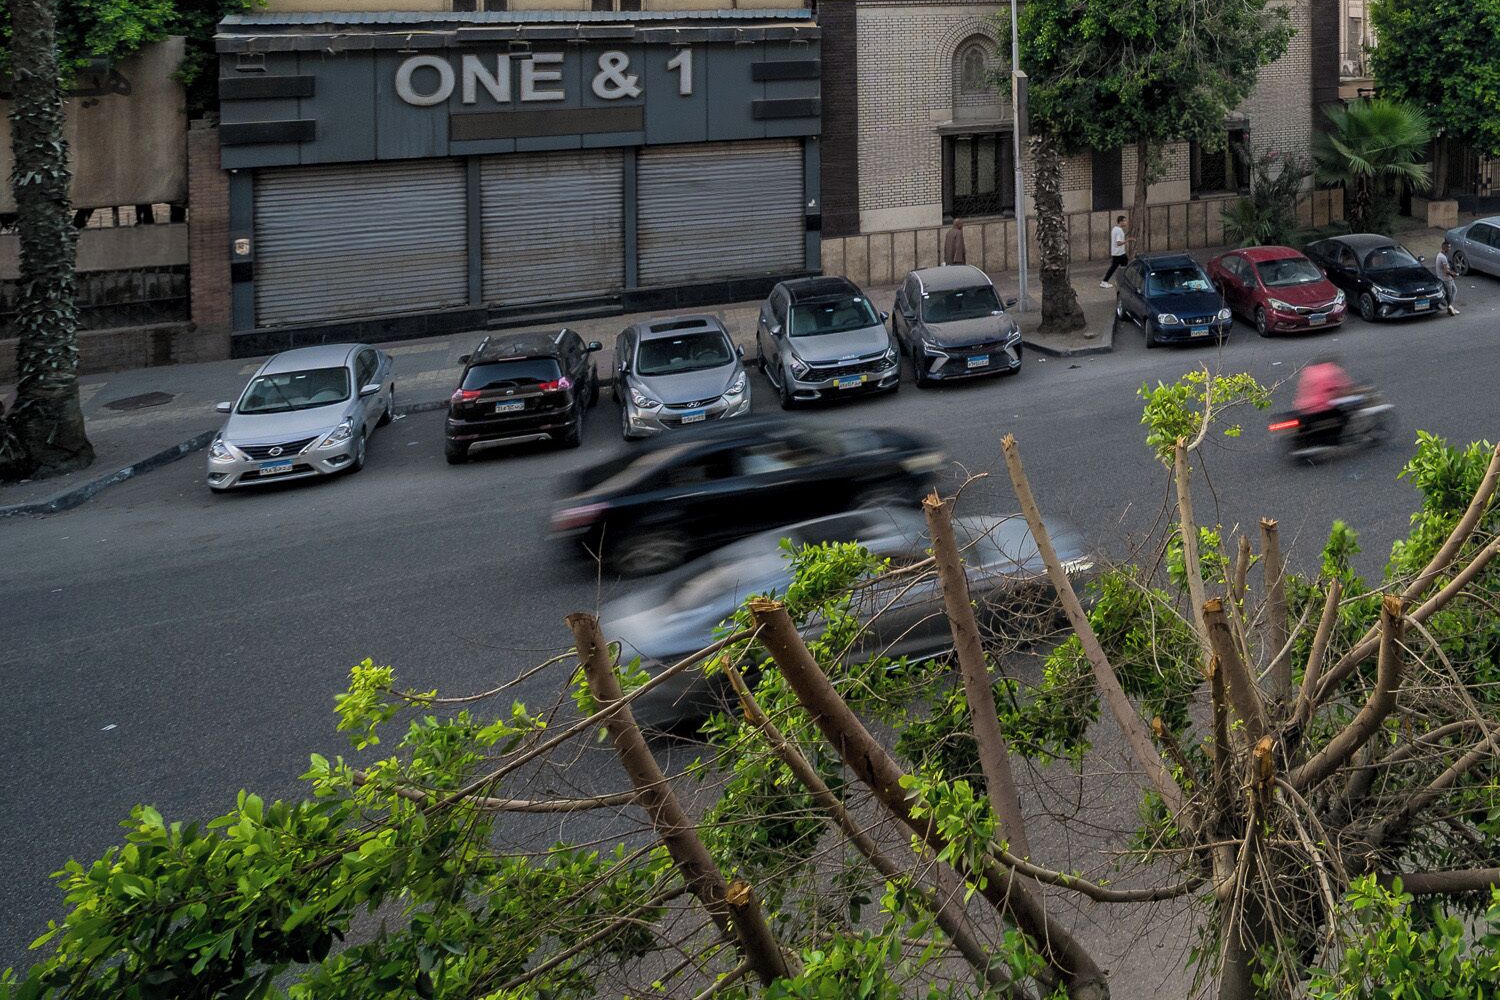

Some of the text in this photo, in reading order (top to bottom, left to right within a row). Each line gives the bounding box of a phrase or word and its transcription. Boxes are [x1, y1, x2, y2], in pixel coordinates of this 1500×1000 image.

[395, 49, 693, 107] ONE & 1
